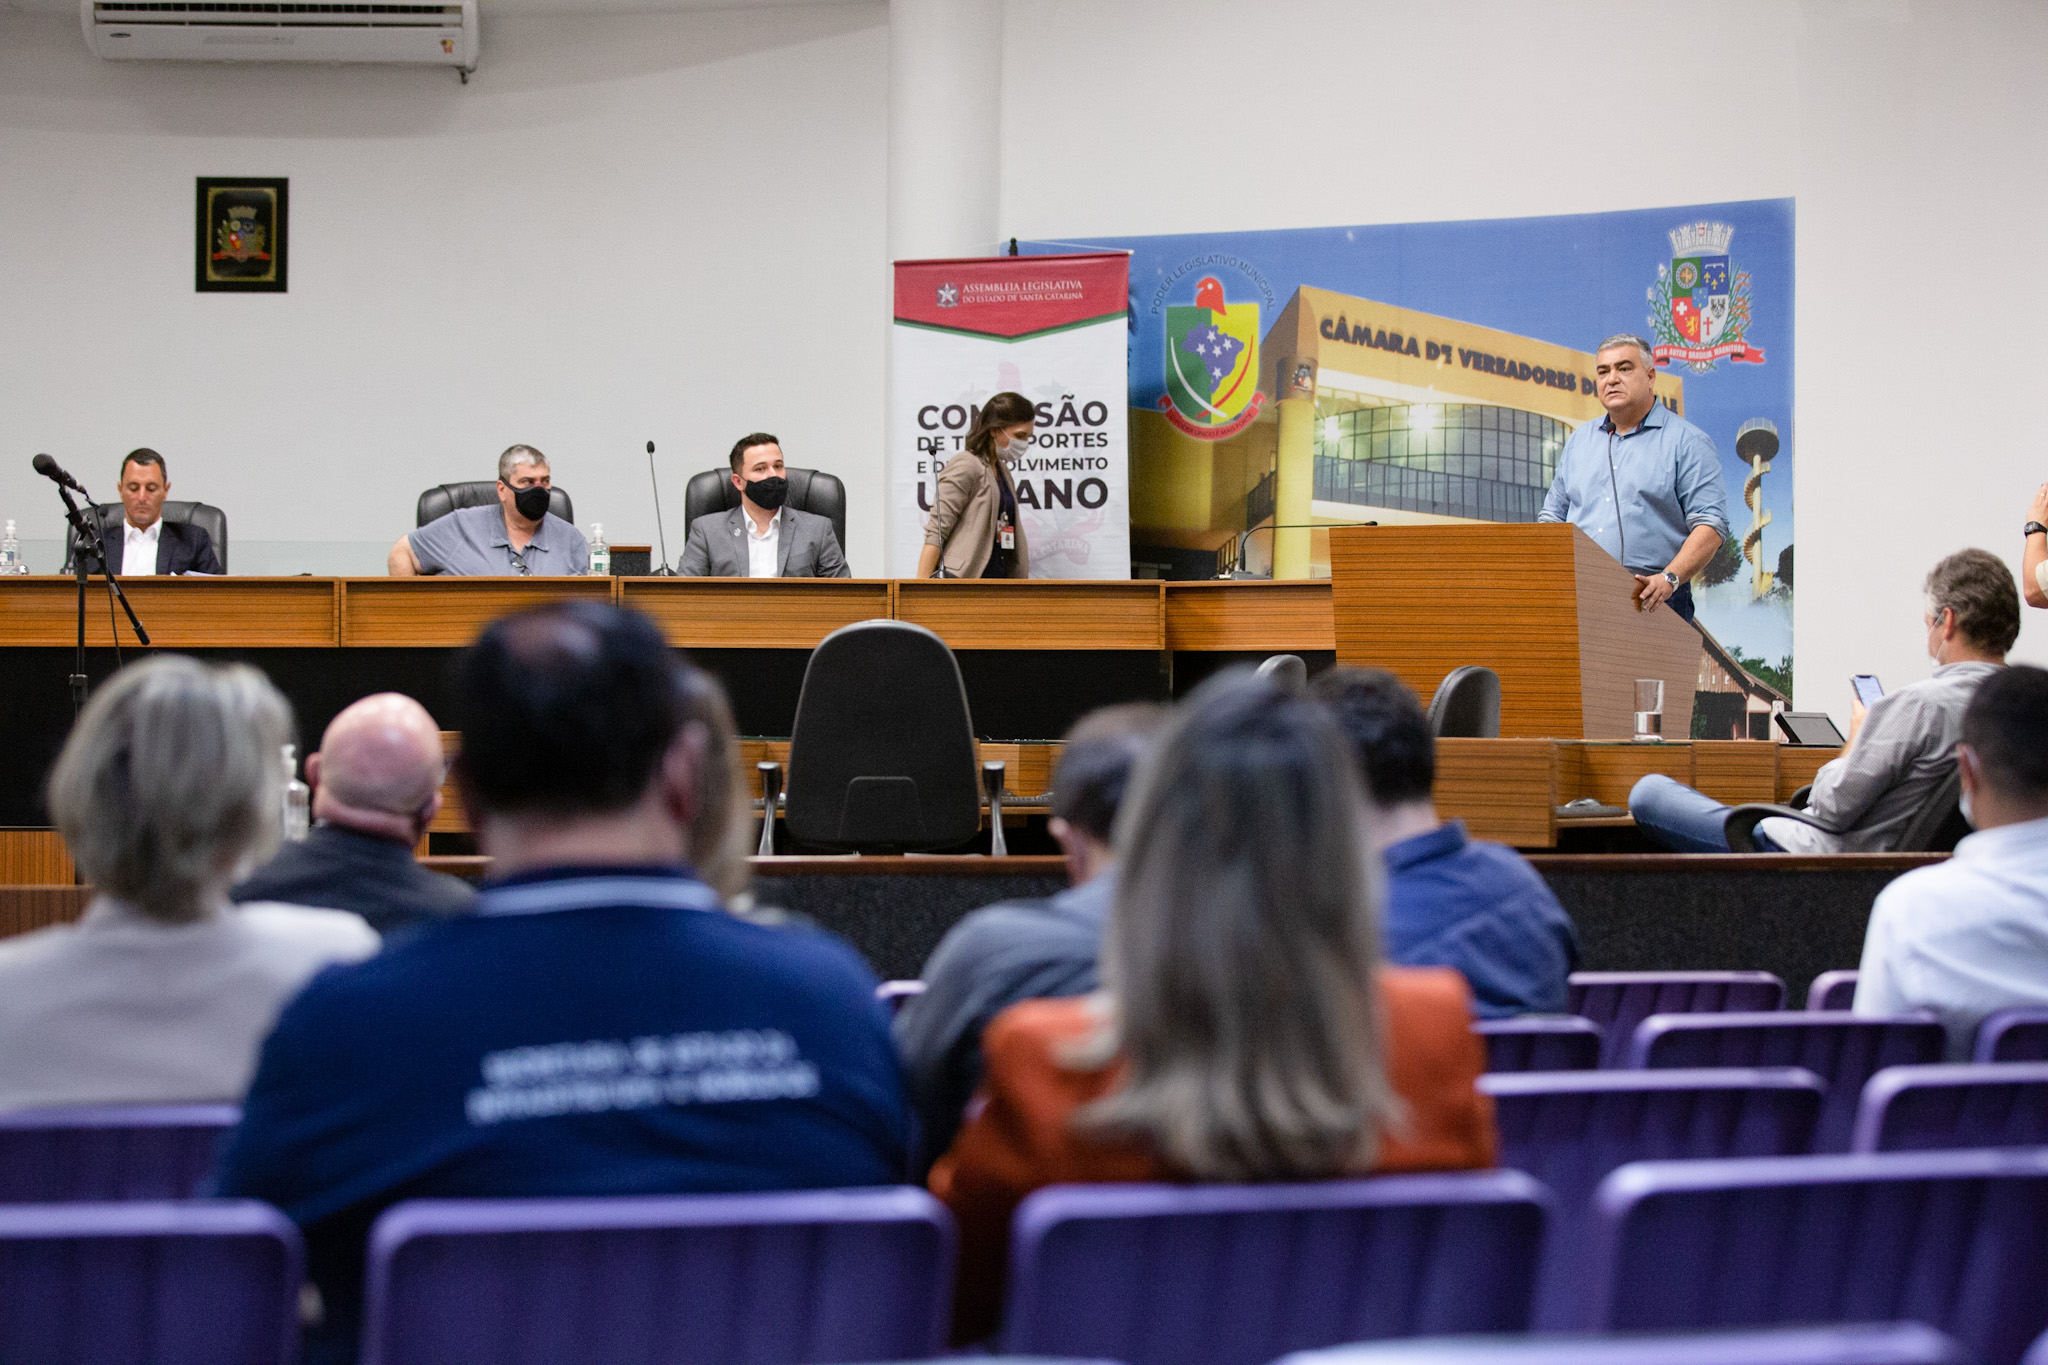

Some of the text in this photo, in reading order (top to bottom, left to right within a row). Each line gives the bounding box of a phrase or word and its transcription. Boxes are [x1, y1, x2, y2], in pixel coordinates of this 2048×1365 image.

[962, 280, 1083, 293] ASSEMBLEIA LEGISLATIVA
[1151, 254, 1275, 314] PODER LEGISLATIVO MUNICIPAL
[962, 291, 1083, 303] DO ESTADO DE SANTA CATARINA
[1319, 314, 1421, 358] CÂMARA
[1457, 347, 1577, 391] VEREADORES
[917, 394, 1108, 431] COSÃO
[917, 436, 945, 452] DE
[917, 461, 927, 474] E
[917, 477, 1108, 512] UANO
